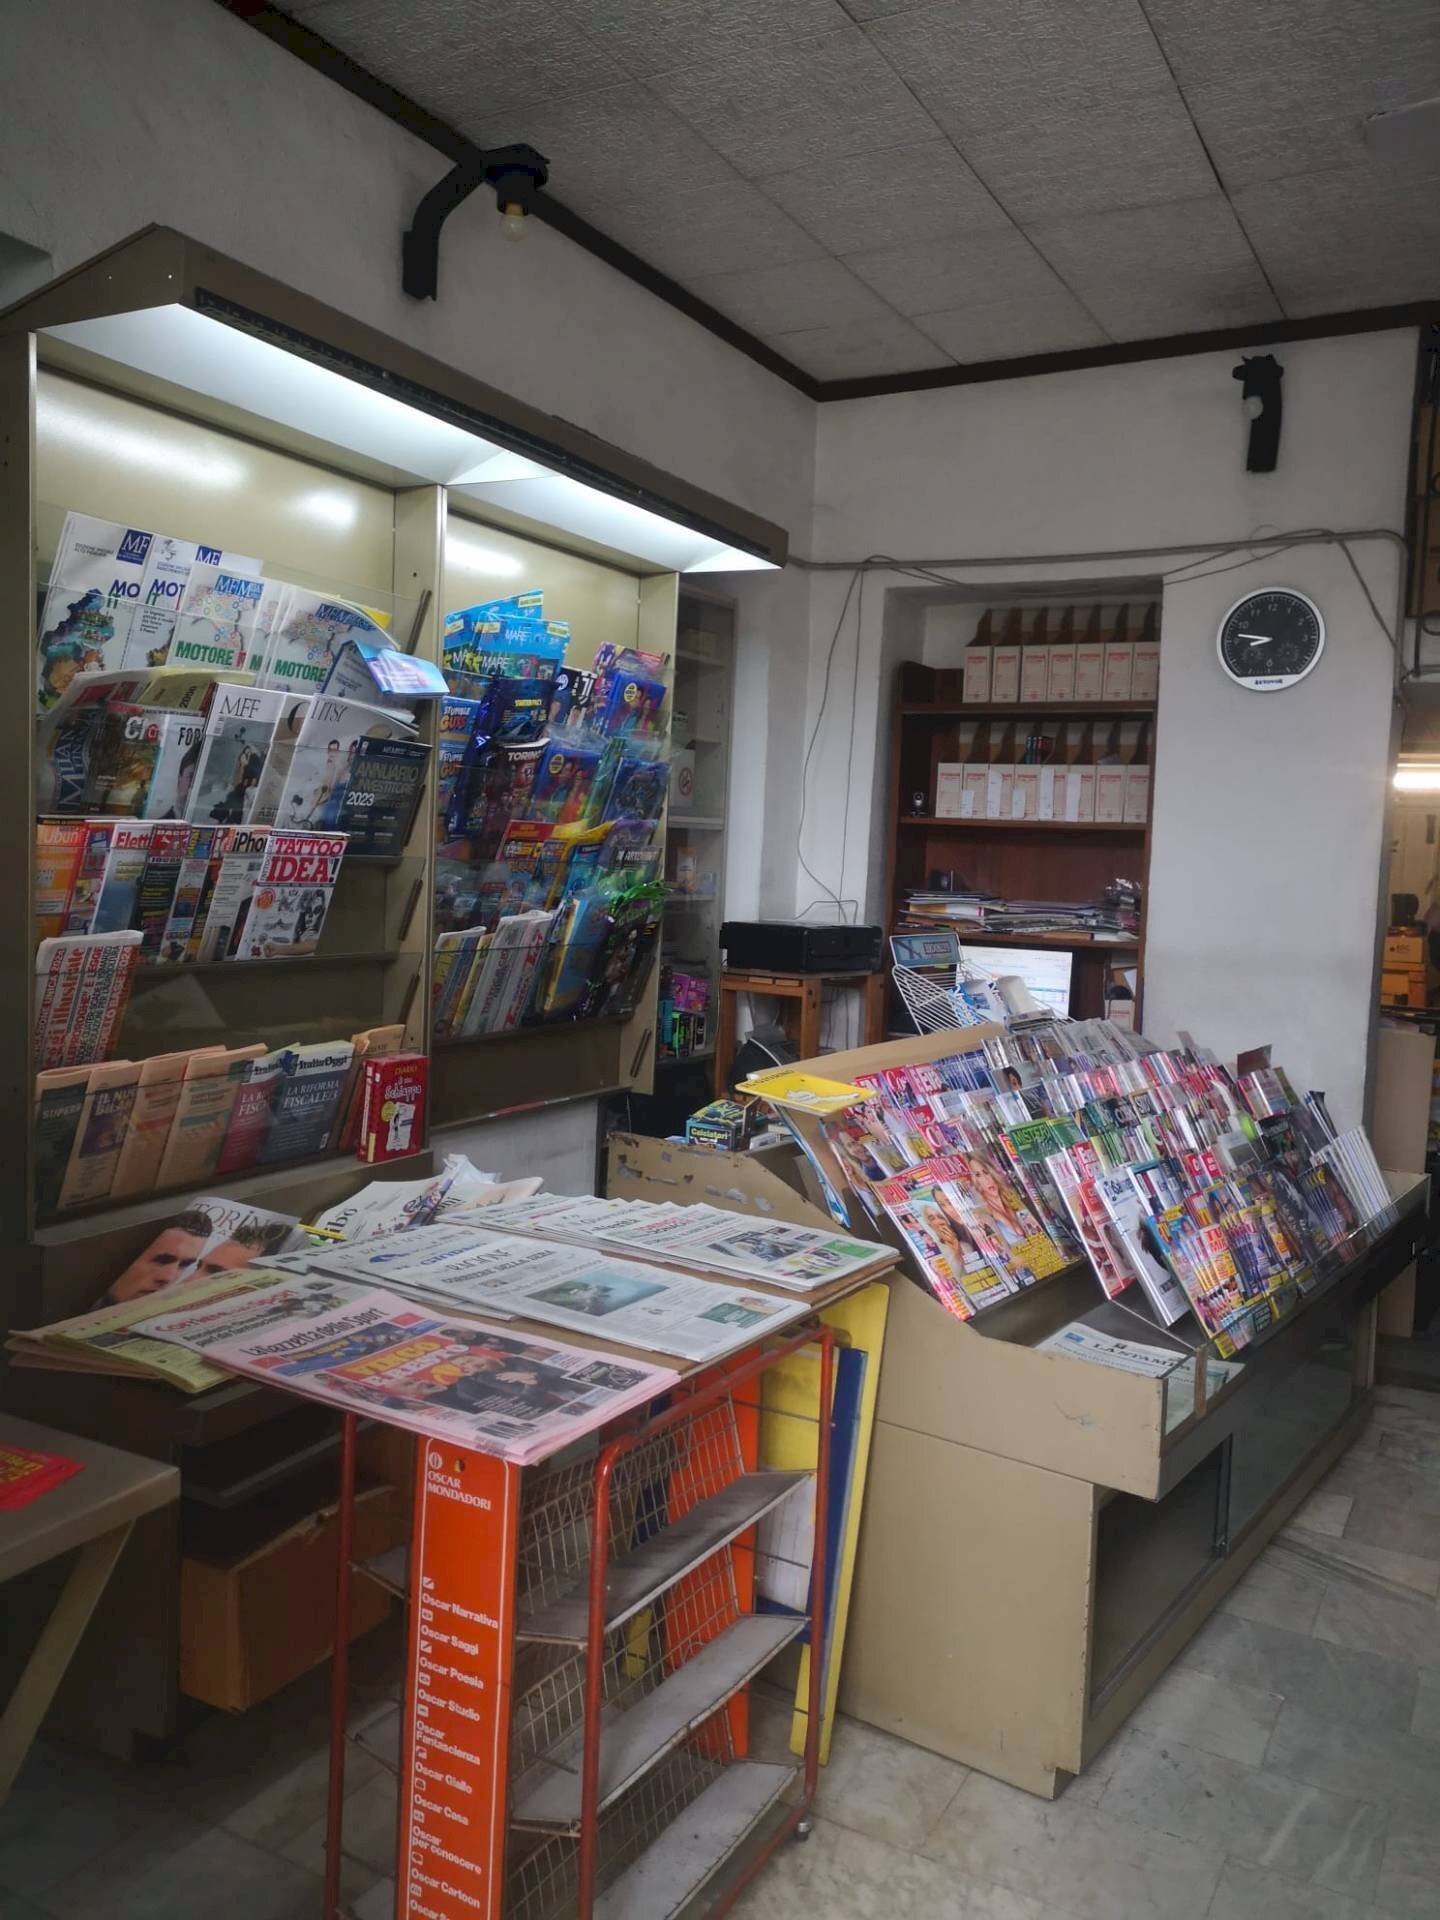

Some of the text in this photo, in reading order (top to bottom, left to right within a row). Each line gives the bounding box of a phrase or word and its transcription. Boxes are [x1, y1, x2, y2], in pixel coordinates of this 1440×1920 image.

[122, 533, 151, 554] MF
[175, 640, 235, 666] MOTORE
[273, 659, 327, 683] MOTORE
[219, 695, 261, 718] MFF
[346, 791, 375, 807] 2023
[232, 830, 267, 852] iPho
[275, 837, 344, 856] TATTOO
[267, 856, 340, 883] IDEA!
[299, 1080, 340, 1094] RIFORMA
[690, 1127, 728, 1141] Calciatori
[256, 1328, 323, 1356] Gazzetta
[321, 1318, 351, 1339] dello
[349, 1306, 392, 1328] Sport
[428, 1470, 461, 1489] OSCAR
[427, 1482, 492, 1511] MONDADORI
[422, 1593, 499, 1629] Oscar Narrativa
[420, 1625, 479, 1656] Oscar Saggi
[419, 1656, 485, 1690] Oscar Poesia
[418, 1689, 481, 1722] Oscar Studio
[416, 1720, 446, 1740] Oscar
[416, 1731, 481, 1766] Fantascienza
[414, 1761, 473, 1794] Oscar Giallo
[414, 1794, 469, 1826] Oscar Casa
[412, 1825, 442, 1846] Oscar
[411, 1837, 482, 1876] per conoscere
[411, 1868, 481, 1910] Oscar Cartoon
[410, 1899, 439, 1919] Oscar
